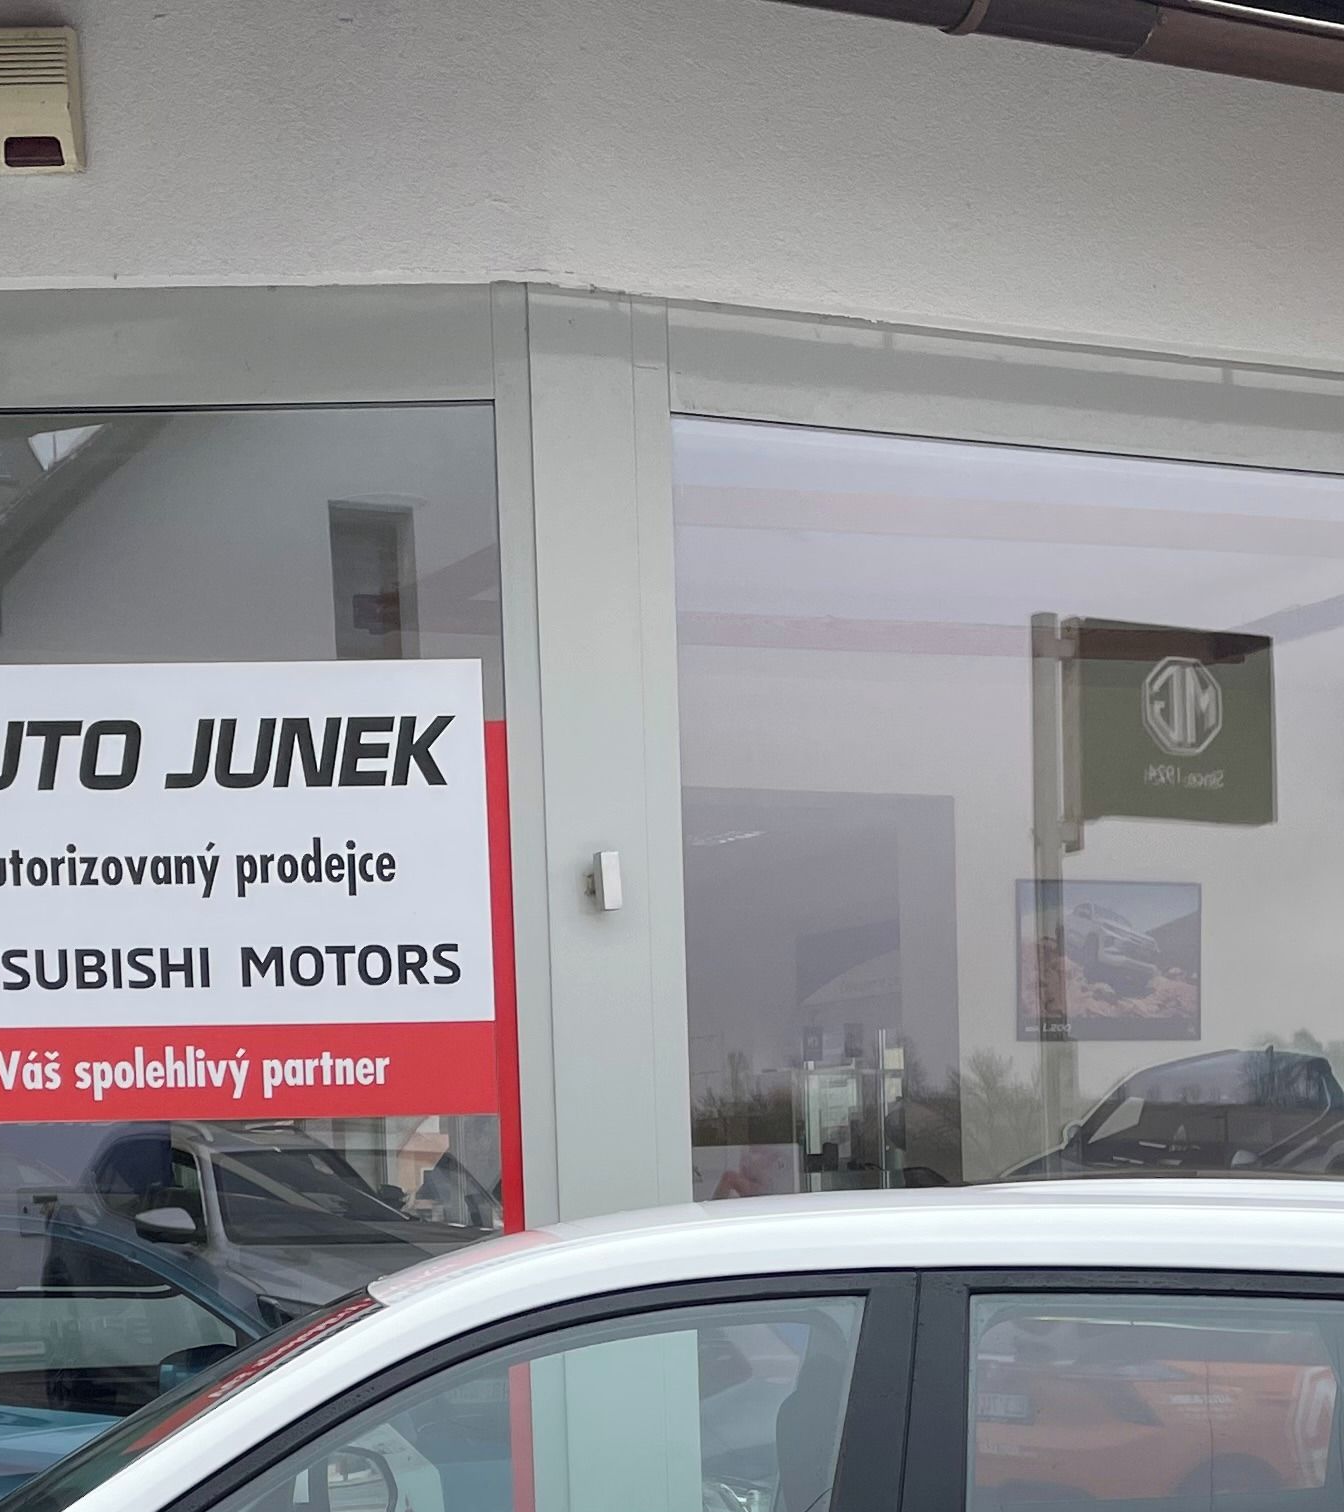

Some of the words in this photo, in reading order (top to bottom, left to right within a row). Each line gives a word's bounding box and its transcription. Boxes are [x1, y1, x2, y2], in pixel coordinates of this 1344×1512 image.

[165, 715, 456, 790] JUNEK
[236, 837, 397, 899] prodejce
[241, 943, 462, 989] MOTORS
[74, 1046, 251, 1102] spolehlivý
[262, 1051, 391, 1099] partner
